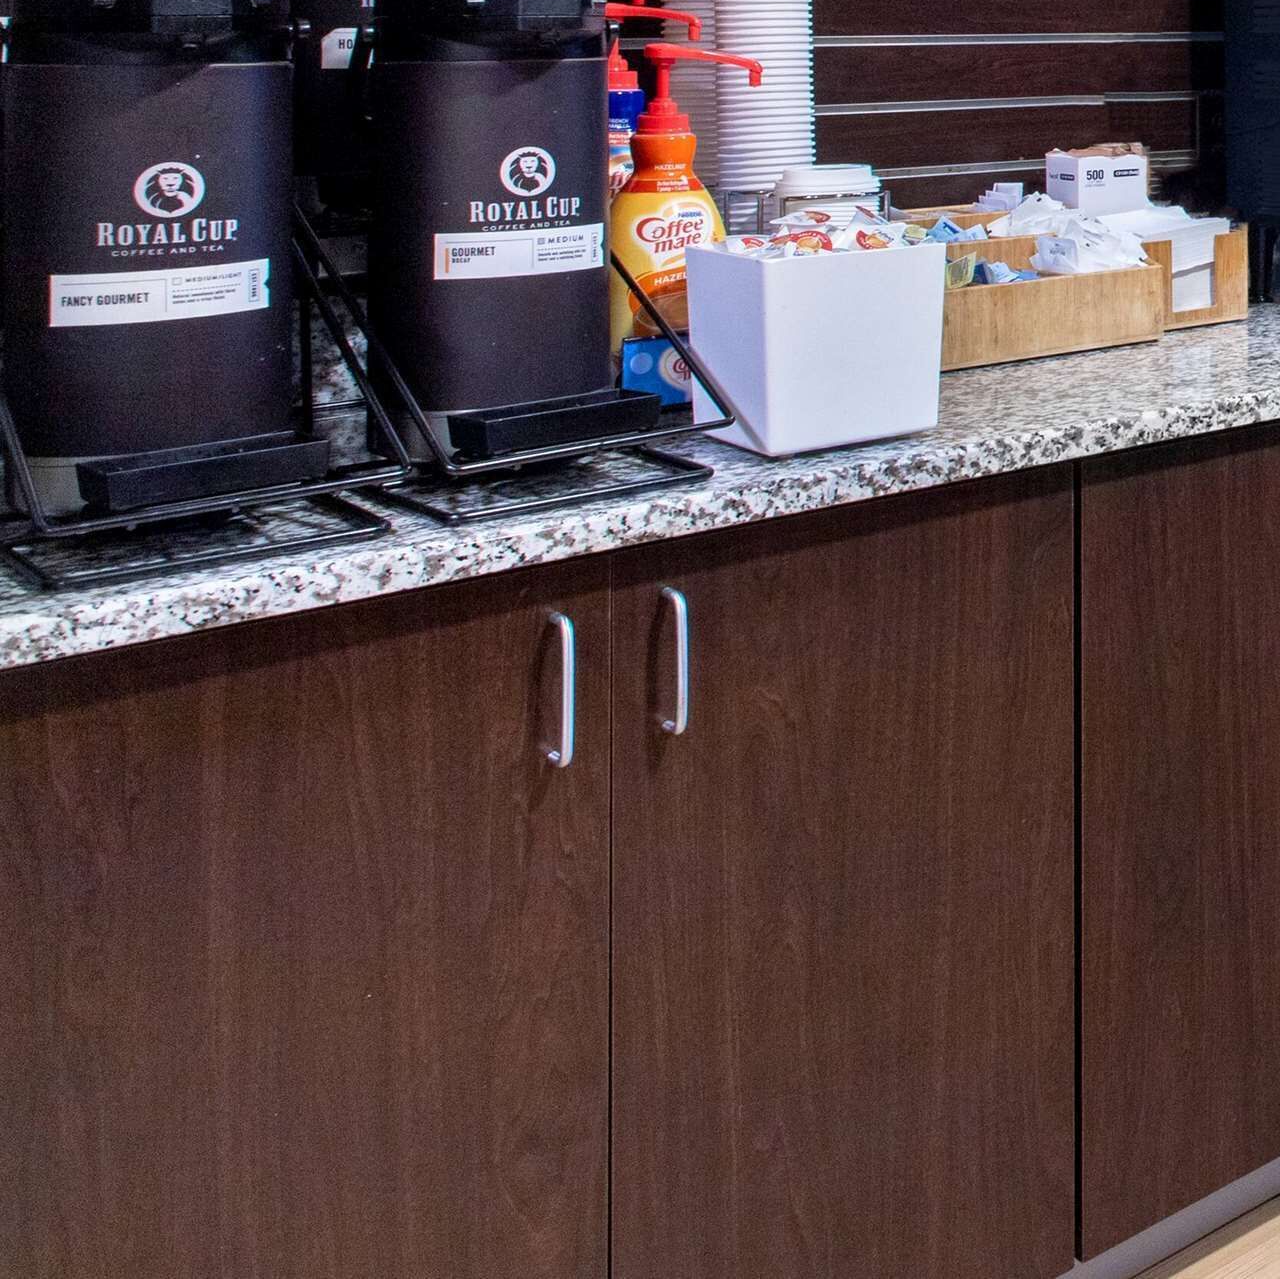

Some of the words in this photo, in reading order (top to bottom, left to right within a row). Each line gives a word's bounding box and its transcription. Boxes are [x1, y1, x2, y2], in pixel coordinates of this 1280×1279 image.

[1086, 169, 1105, 181] 500
[469, 201, 543, 223] ROYAL
[546, 197, 581, 218] CUP
[97, 221, 186, 247] ROYAL
[192, 218, 238, 241] CUP
[482, 224, 525, 232] COFFEE
[636, 217, 704, 243] Coffee
[547, 234, 584, 244] MEDIUM
[654, 232, 702, 254] mate
[112, 248, 165, 257] COFFEE
[170, 246, 196, 254] AND
[451, 246, 496, 257] GOURMET
[654, 271, 688, 286] HAZEL
[61, 295, 93, 308] FANCY
[96, 292, 149, 307] GOURMET
